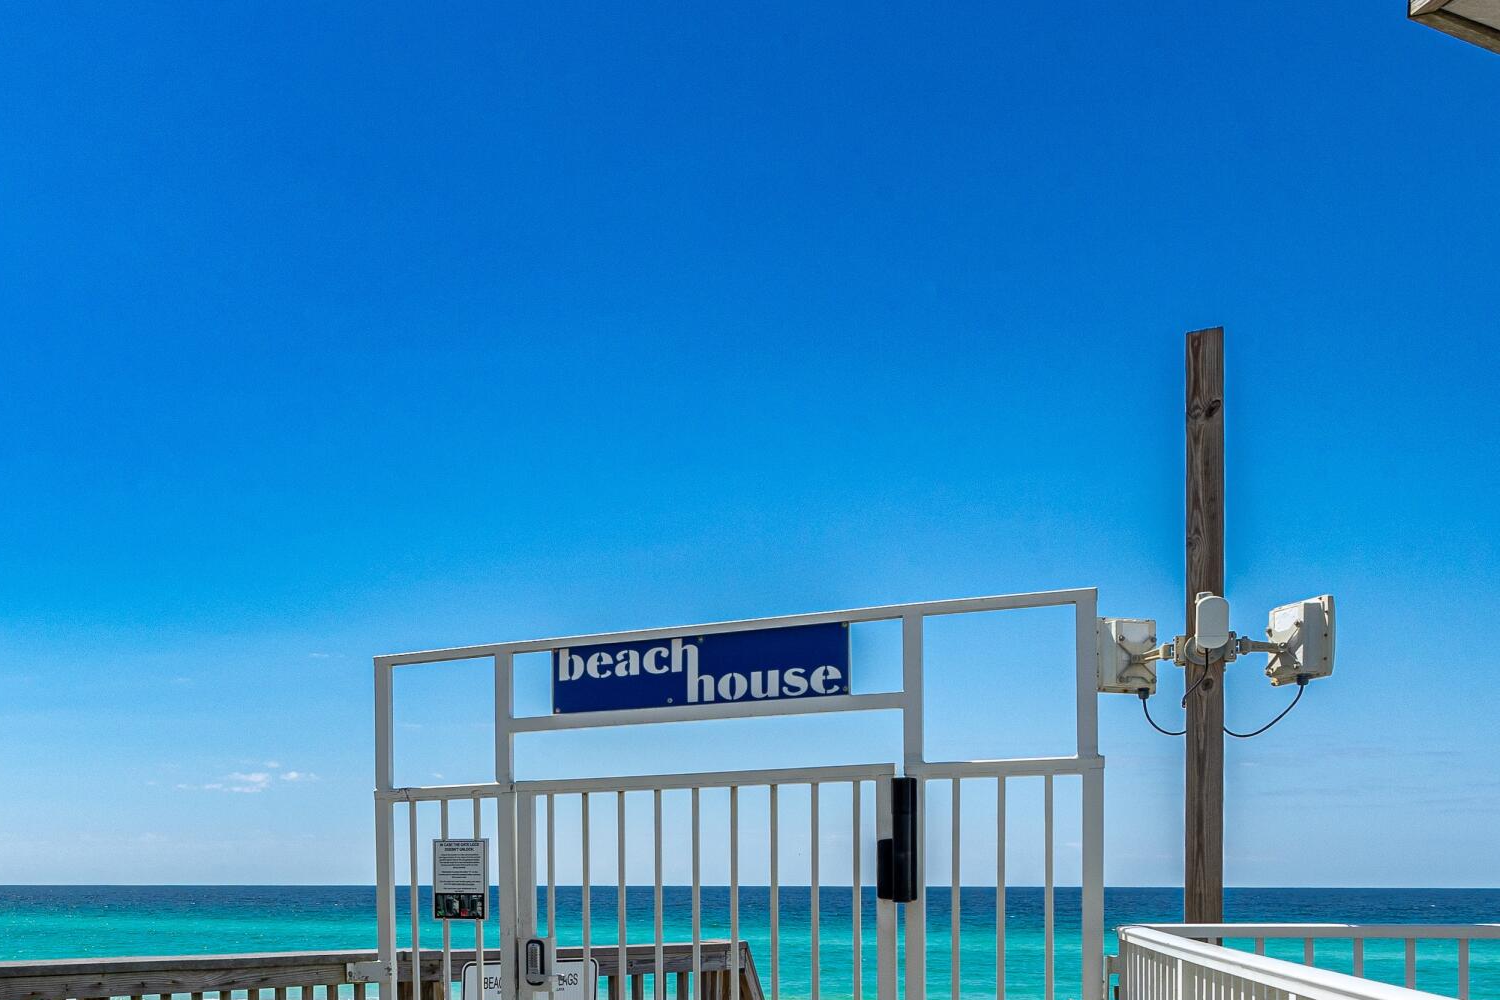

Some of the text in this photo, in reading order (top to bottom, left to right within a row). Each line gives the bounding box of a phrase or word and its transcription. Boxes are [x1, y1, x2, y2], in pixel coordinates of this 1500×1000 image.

[558, 638, 699, 682] beach
[687, 658, 842, 703] house
[484, 973, 578, 989] BEA LAGS
